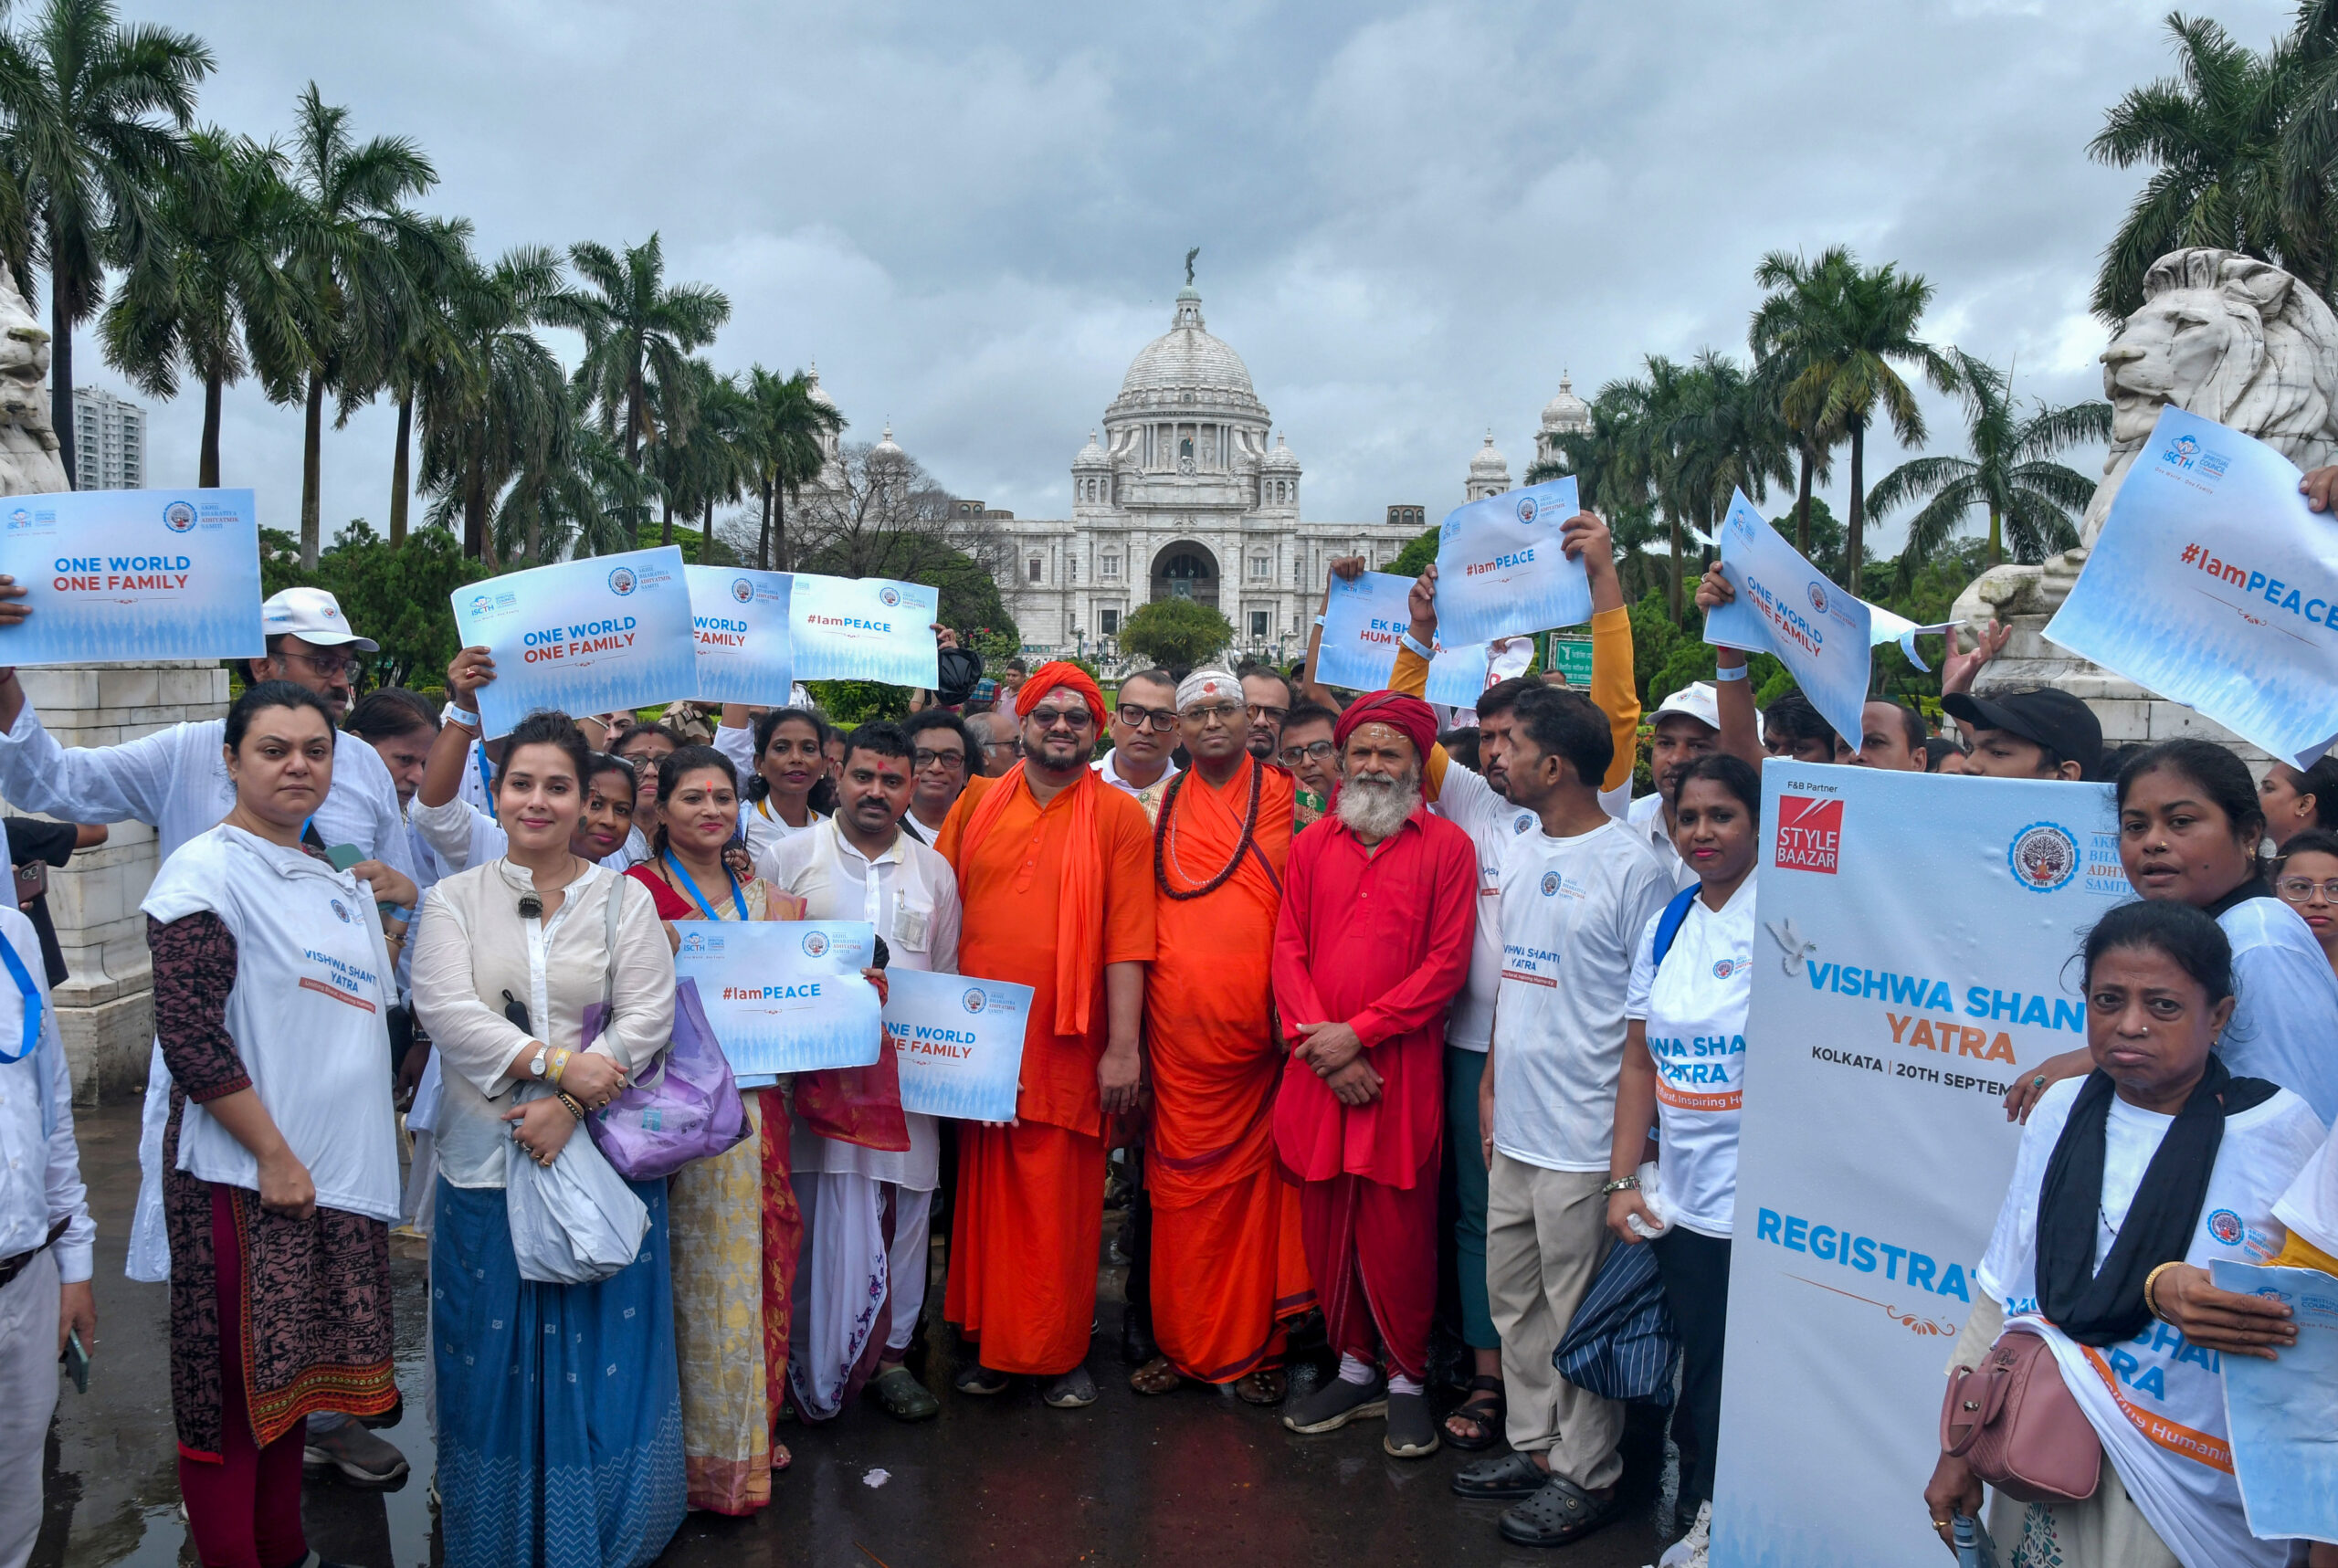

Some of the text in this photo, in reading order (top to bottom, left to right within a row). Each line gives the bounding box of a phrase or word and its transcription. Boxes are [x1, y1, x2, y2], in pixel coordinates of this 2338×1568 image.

[55, 555, 191, 573] ONE WORLD
[1466, 549, 1534, 576] #IamPEACE
[53, 574, 188, 592] ONE FAMILY
[2180, 542, 2338, 632] #IamPEACE
[1747, 576, 1773, 605] ONE
[1775, 597, 1823, 644] WORLD
[523, 616, 637, 647] ONE WORLD
[694, 616, 747, 633] WORLD
[807, 614, 891, 633] #IamPEACE
[1371, 618, 1388, 631] EK
[1748, 590, 1821, 658] ONE FAMILY
[1360, 630, 1392, 644] HUM
[524, 633, 636, 664] ONE FAMILY
[1787, 781, 1838, 793] F&B Partner
[1779, 826, 1838, 851] STYLE
[1777, 847, 1836, 868] BAAZAR
[303, 948, 346, 973] VISHWA
[1511, 957, 1536, 971] YATRA
[331, 971, 359, 993] YATRA
[722, 984, 821, 1001] #IamPEACE
[1806, 960, 2086, 1034] VISHWA SHAN
[882, 1021, 976, 1044] NE WORLD
[1885, 1012, 2017, 1066] YATRA
[911, 1040, 973, 1059] FAMILY
[1812, 1046, 1883, 1072] KOLKATA
[1896, 1063, 1939, 1084] 20TH
[1679, 1095, 1726, 1108] Inspiring
[1757, 1206, 1977, 1303] REGISTRA
